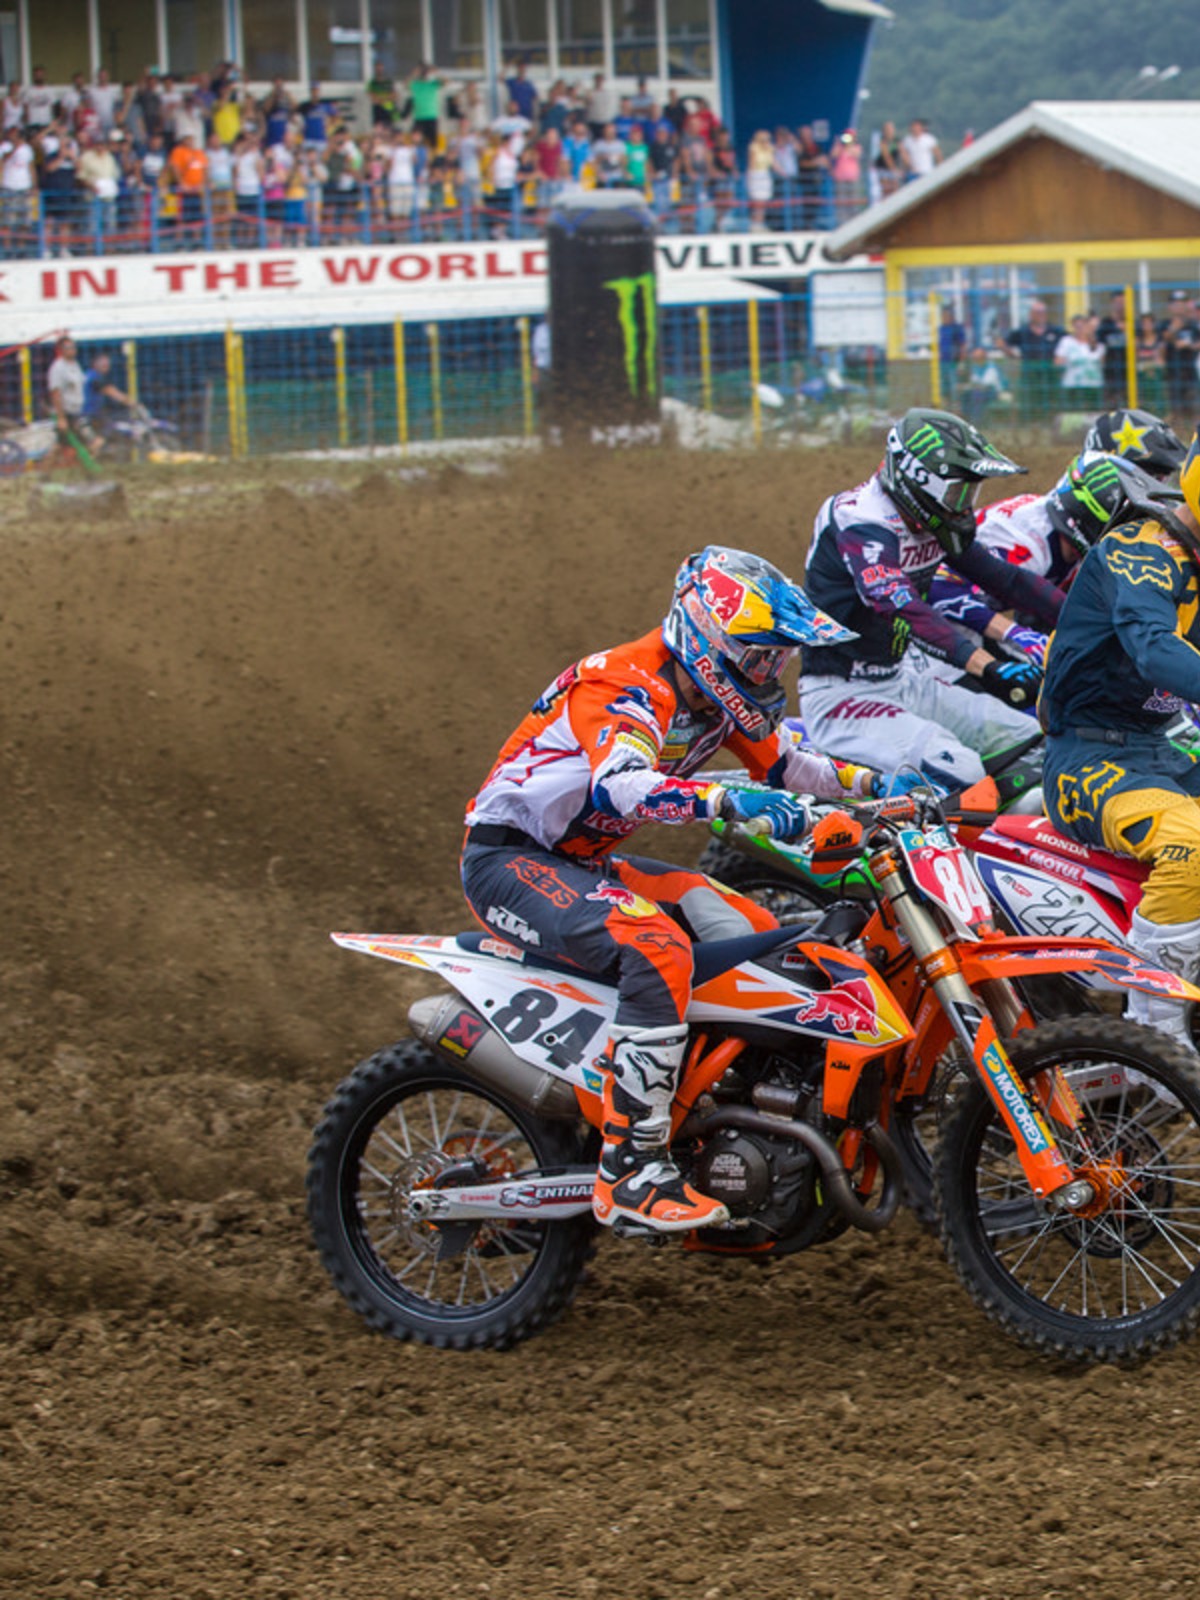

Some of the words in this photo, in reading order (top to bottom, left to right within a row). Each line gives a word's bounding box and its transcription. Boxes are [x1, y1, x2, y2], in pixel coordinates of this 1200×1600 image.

[41, 268, 118, 299] IN
[155, 259, 300, 292] THE
[321, 249, 548, 284] WORLD
[693, 653, 734, 703] Red
[722, 695, 766, 733] Bull
[823, 832, 853, 849] KTM
[1028, 848, 1082, 881] MOTUL
[1034, 830, 1091, 859] HONDA
[1159, 844, 1197, 864] FOX
[932, 851, 994, 923] 84
[485, 905, 542, 947] KTM
[1018, 883, 1132, 948] 24
[490, 987, 607, 1071] 84
[993, 1072, 1046, 1151] MOTOREX
